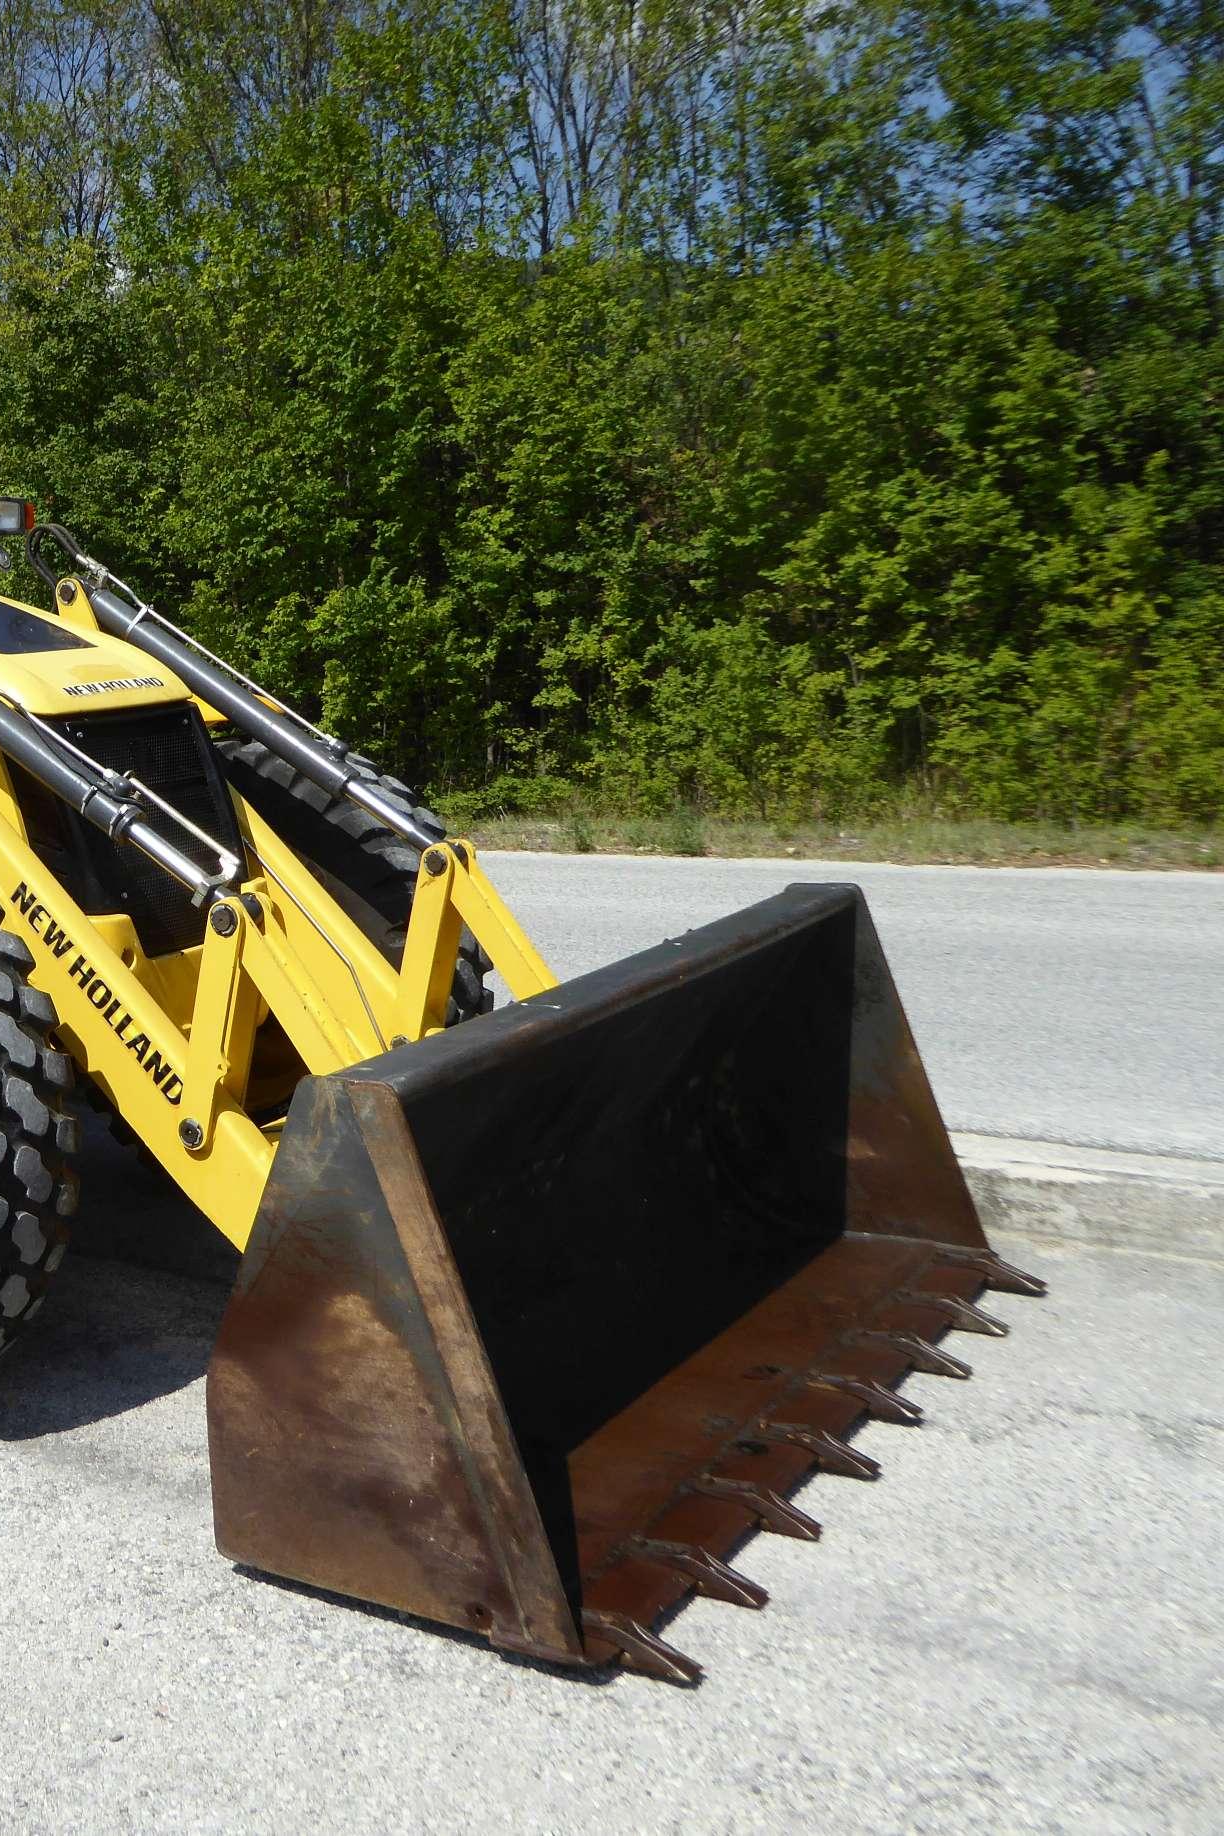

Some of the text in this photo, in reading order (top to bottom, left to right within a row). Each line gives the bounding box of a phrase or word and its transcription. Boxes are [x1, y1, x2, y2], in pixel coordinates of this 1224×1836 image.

[63, 677, 164, 696] NEW HOLLAND
[10, 881, 184, 1105] NEW HOLLAND
